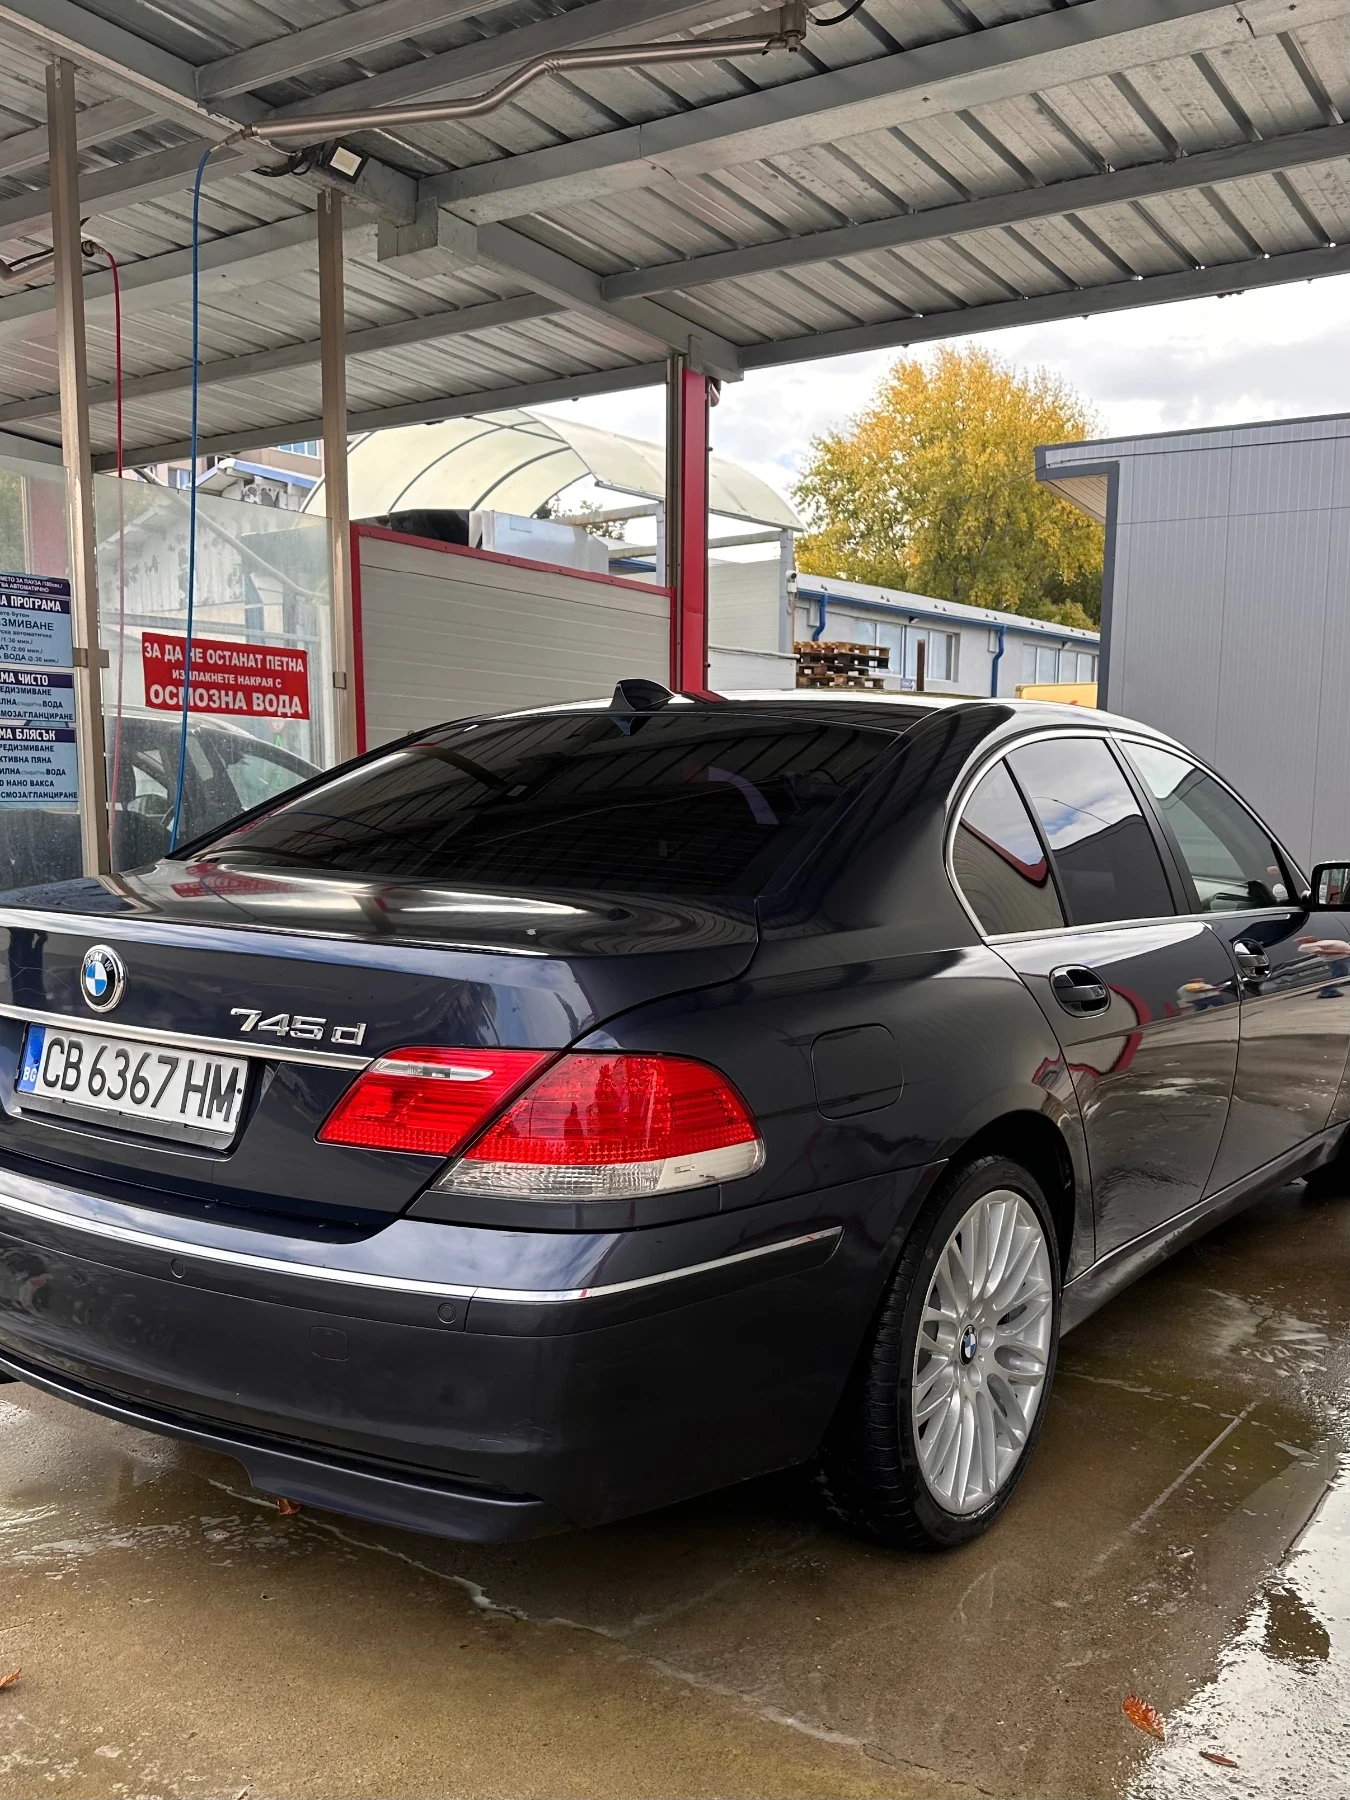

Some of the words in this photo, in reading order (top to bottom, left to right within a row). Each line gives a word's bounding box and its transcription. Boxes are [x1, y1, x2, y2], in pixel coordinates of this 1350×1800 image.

[10, 595, 62, 612] ПРОГРАМА
[0, 617, 54, 631] ЗМИВАНЕ
[4, 652, 27, 662] ВОДА
[144, 642, 162, 659] ЗА
[164, 644, 184, 663] ДА
[206, 649, 263, 669] ОСТАНАТ
[266, 655, 304, 673] ПЕТНА
[18, 672, 49, 686] ЧИСТО
[172, 669, 235, 685] ИЗЛАКНЕТЕ
[237, 676, 274, 688] НАКРАЯ
[275, 678, 282, 688] С
[0, 685, 52, 697] ЕДИЗМИВАНЕ
[42, 700, 64, 709] ВОДА
[149, 683, 248, 711] ОСМОЗНА
[252, 692, 303, 717] ВОДА
[16, 729, 56, 741] БЛЯСЪК
[31, 756, 52, 764] ПЯНА
[46, 768, 66, 777] ВОДА
[6, 779, 28, 787] НАНО
[30, 779, 55, 788] ВАКСА
[22, 1066, 38, 1082] BG
[87, 1045, 180, 1109] 6367
[179, 1059, 239, 1122] HM
